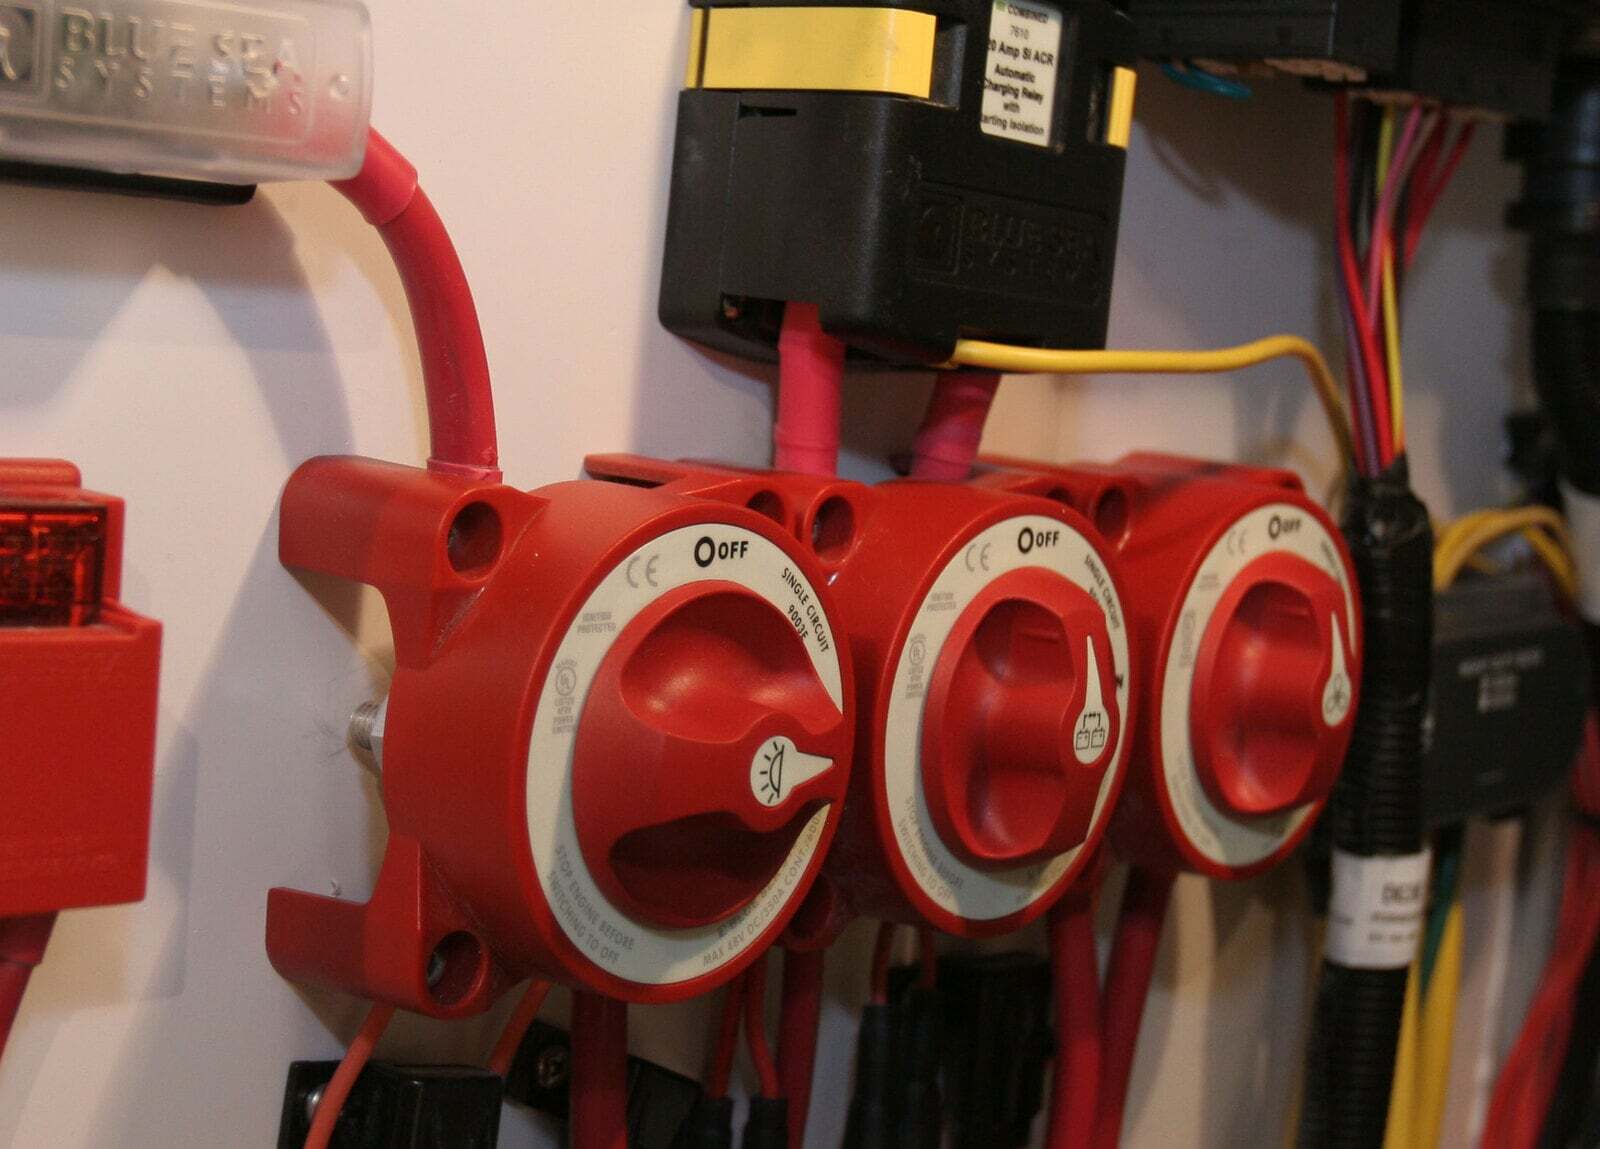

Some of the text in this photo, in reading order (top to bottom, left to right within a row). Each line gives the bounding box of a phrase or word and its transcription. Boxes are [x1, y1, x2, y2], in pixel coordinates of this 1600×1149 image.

[60, 7, 197, 68] BLUE
[998, 41, 1020, 60] Amp
[1034, 49, 1055, 66] ACR
[994, 63, 1036, 84] Automatic
[984, 79, 1045, 106] Charging Relay
[983, 115, 1007, 131] arting
[1035, 530, 1060, 547] OFF
[718, 540, 749, 560] OFF
[781, 567, 830, 653] SINGLE CIRCUIT
[569, 880, 600, 925] ENGINE
[586, 932, 600, 951] TO
[702, 948, 725, 967] MAX
